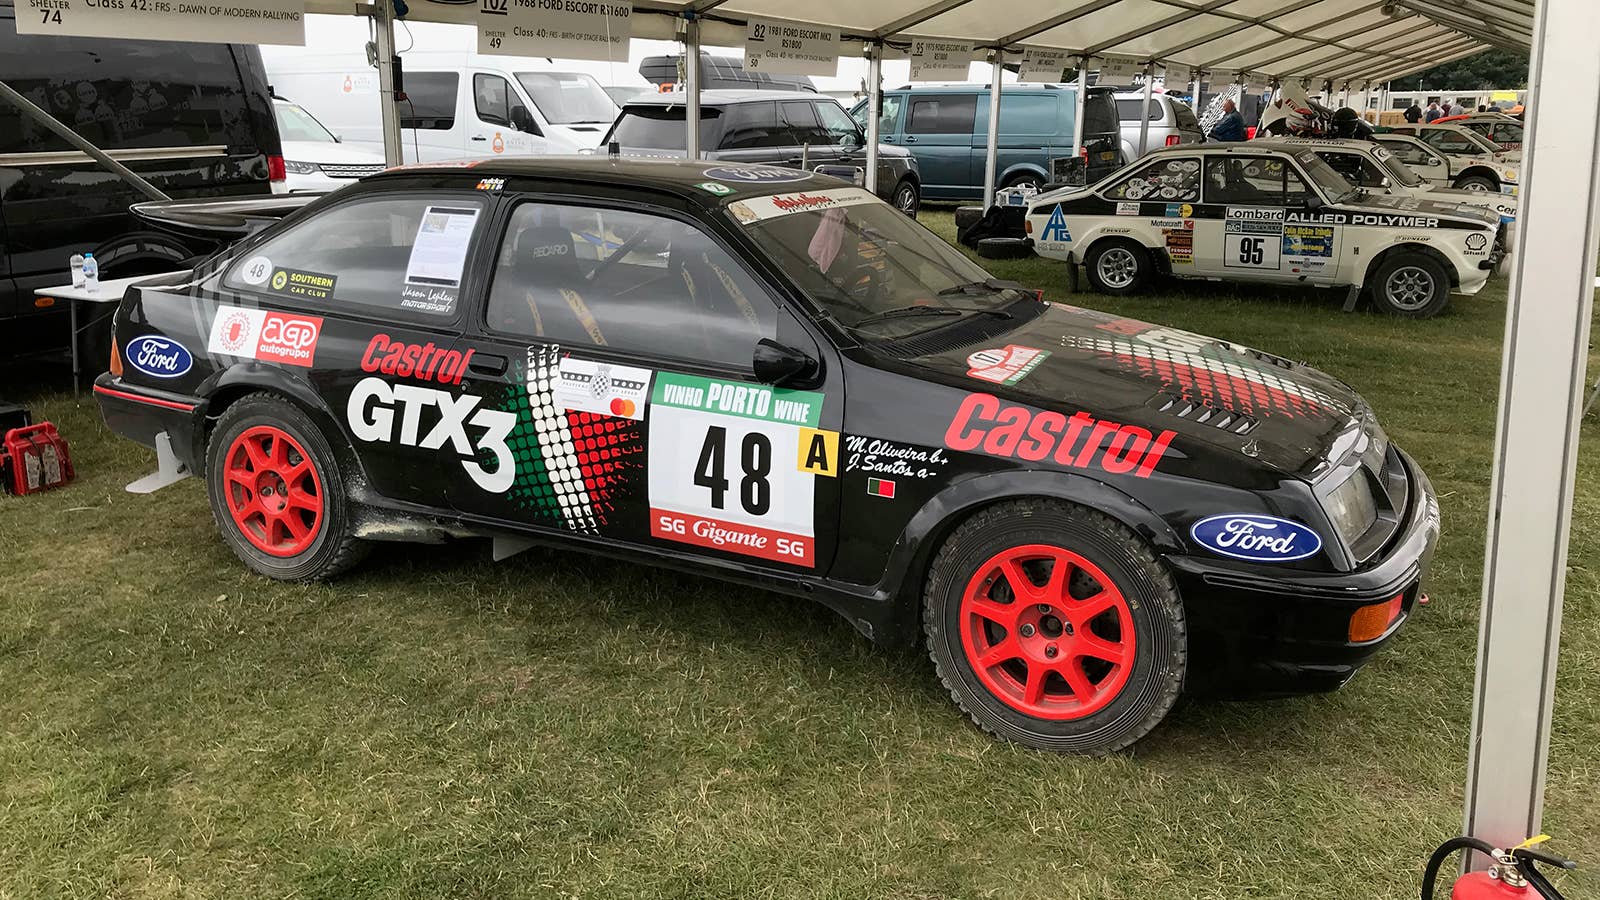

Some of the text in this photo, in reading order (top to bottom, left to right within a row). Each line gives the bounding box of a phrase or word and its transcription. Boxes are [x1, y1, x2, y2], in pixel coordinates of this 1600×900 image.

[30, 0, 70, 9] SHELTER
[86, 0, 124, 9] Class
[155, 3, 171, 12] FRS
[179, 4, 206, 14] DAWN
[209, 6, 222, 15] OF
[223, 8, 261, 18] MODERN
[263, 10, 300, 21] RALLYING
[538, 1, 563, 10] FORD
[565, 2, 598, 14] ESCORT
[600, 4, 629, 17] RS1600
[40, 9, 63, 24] 74
[513, 26, 534, 37] Class
[754, 24, 766, 38] 82
[783, 28, 799, 38] FORD
[799, 30, 820, 40] ESCORT
[489, 38, 502, 48] 49
[916, 42, 925, 54] 95
[750, 59, 759, 67] 50
[1226, 208, 1284, 220] Lombard
[1286, 212, 1439, 228] ALLIED POLYMER
[1150, 220, 1182, 228] Motorcraft
[1239, 237, 1265, 265] 95
[250, 264, 265, 278] 48
[290, 273, 333, 287] SOUTHERN
[290, 287, 326, 298] CAR CLUB
[402, 286, 426, 298] Jason
[400, 299, 451, 313] MOTORSPORT
[137, 339, 179, 372] Ford
[260, 343, 310, 358] autogrupos
[360, 333, 476, 386] Castrol
[663, 382, 811, 423] VINHO PORTO WINE
[347, 377, 518, 494] GTX3
[944, 392, 1178, 479] Castrol
[805, 434, 829, 471] A
[693, 425, 772, 516] 48
[659, 516, 804, 558] SG Gigante SG
[1216, 518, 1297, 554] Ford
